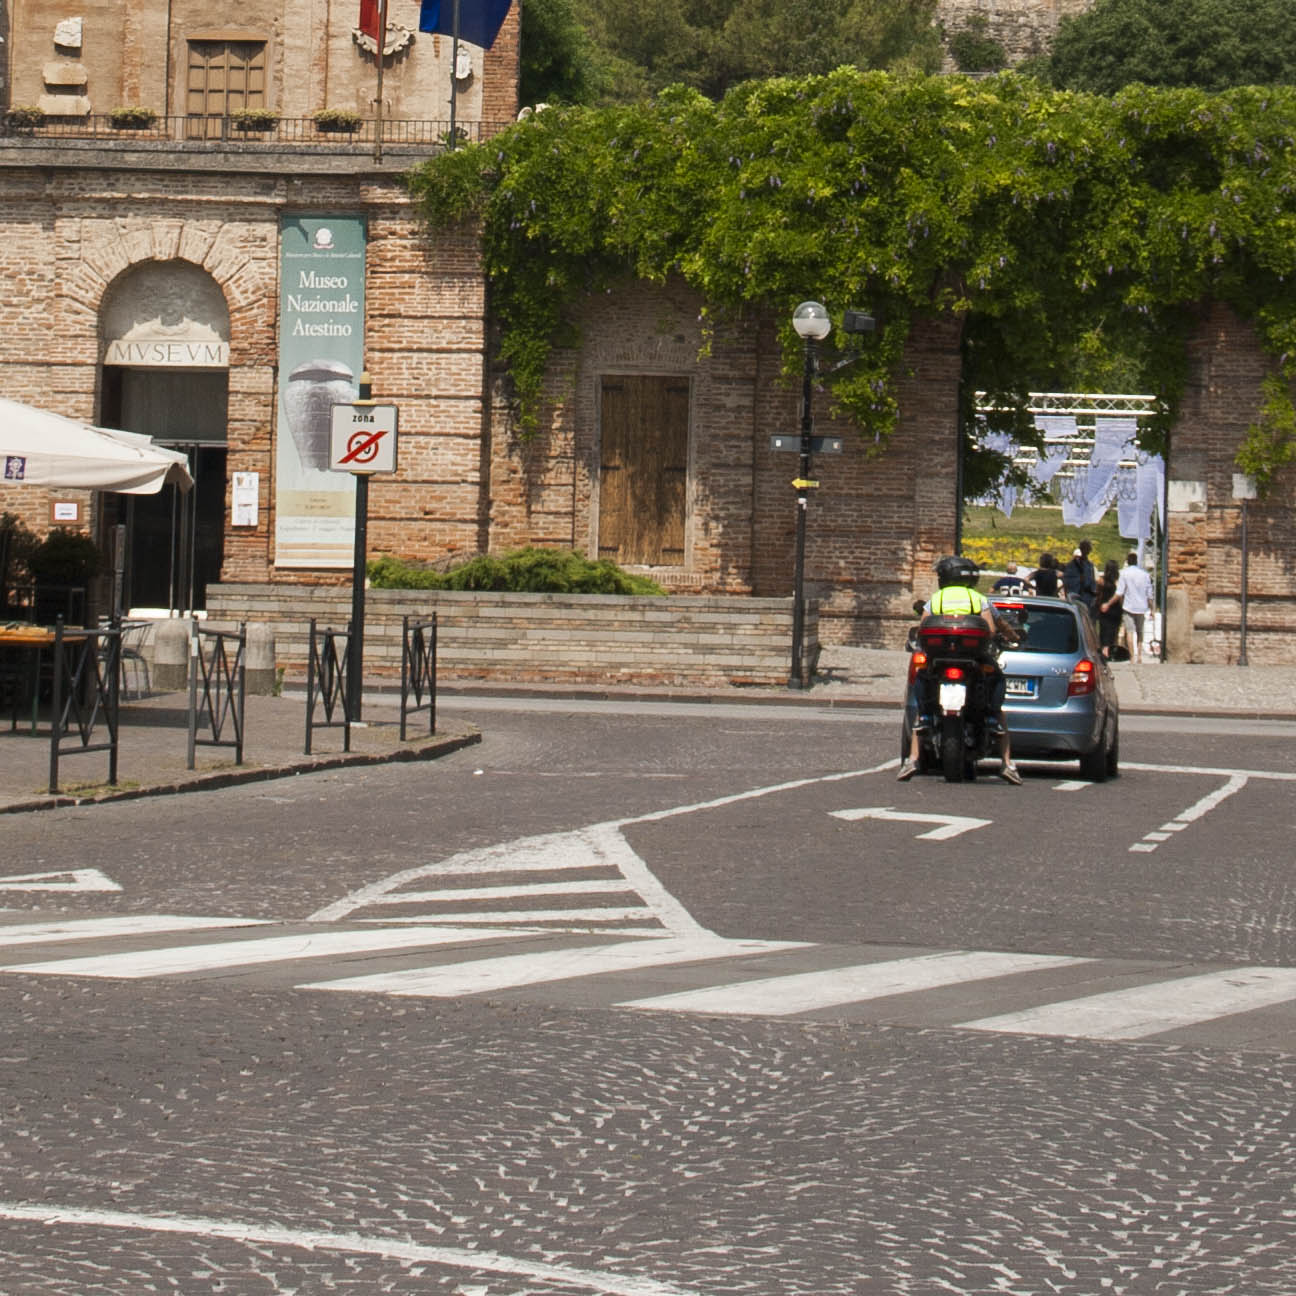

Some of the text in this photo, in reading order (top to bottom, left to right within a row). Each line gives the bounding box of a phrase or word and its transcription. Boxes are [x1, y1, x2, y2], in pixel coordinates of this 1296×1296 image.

[298, 270, 348, 289] Museo
[286, 293, 359, 313] Nazionale
[292, 317, 352, 337] Atestino
[114, 343, 223, 363] MVSEVM
[352, 414, 375, 423] zona
